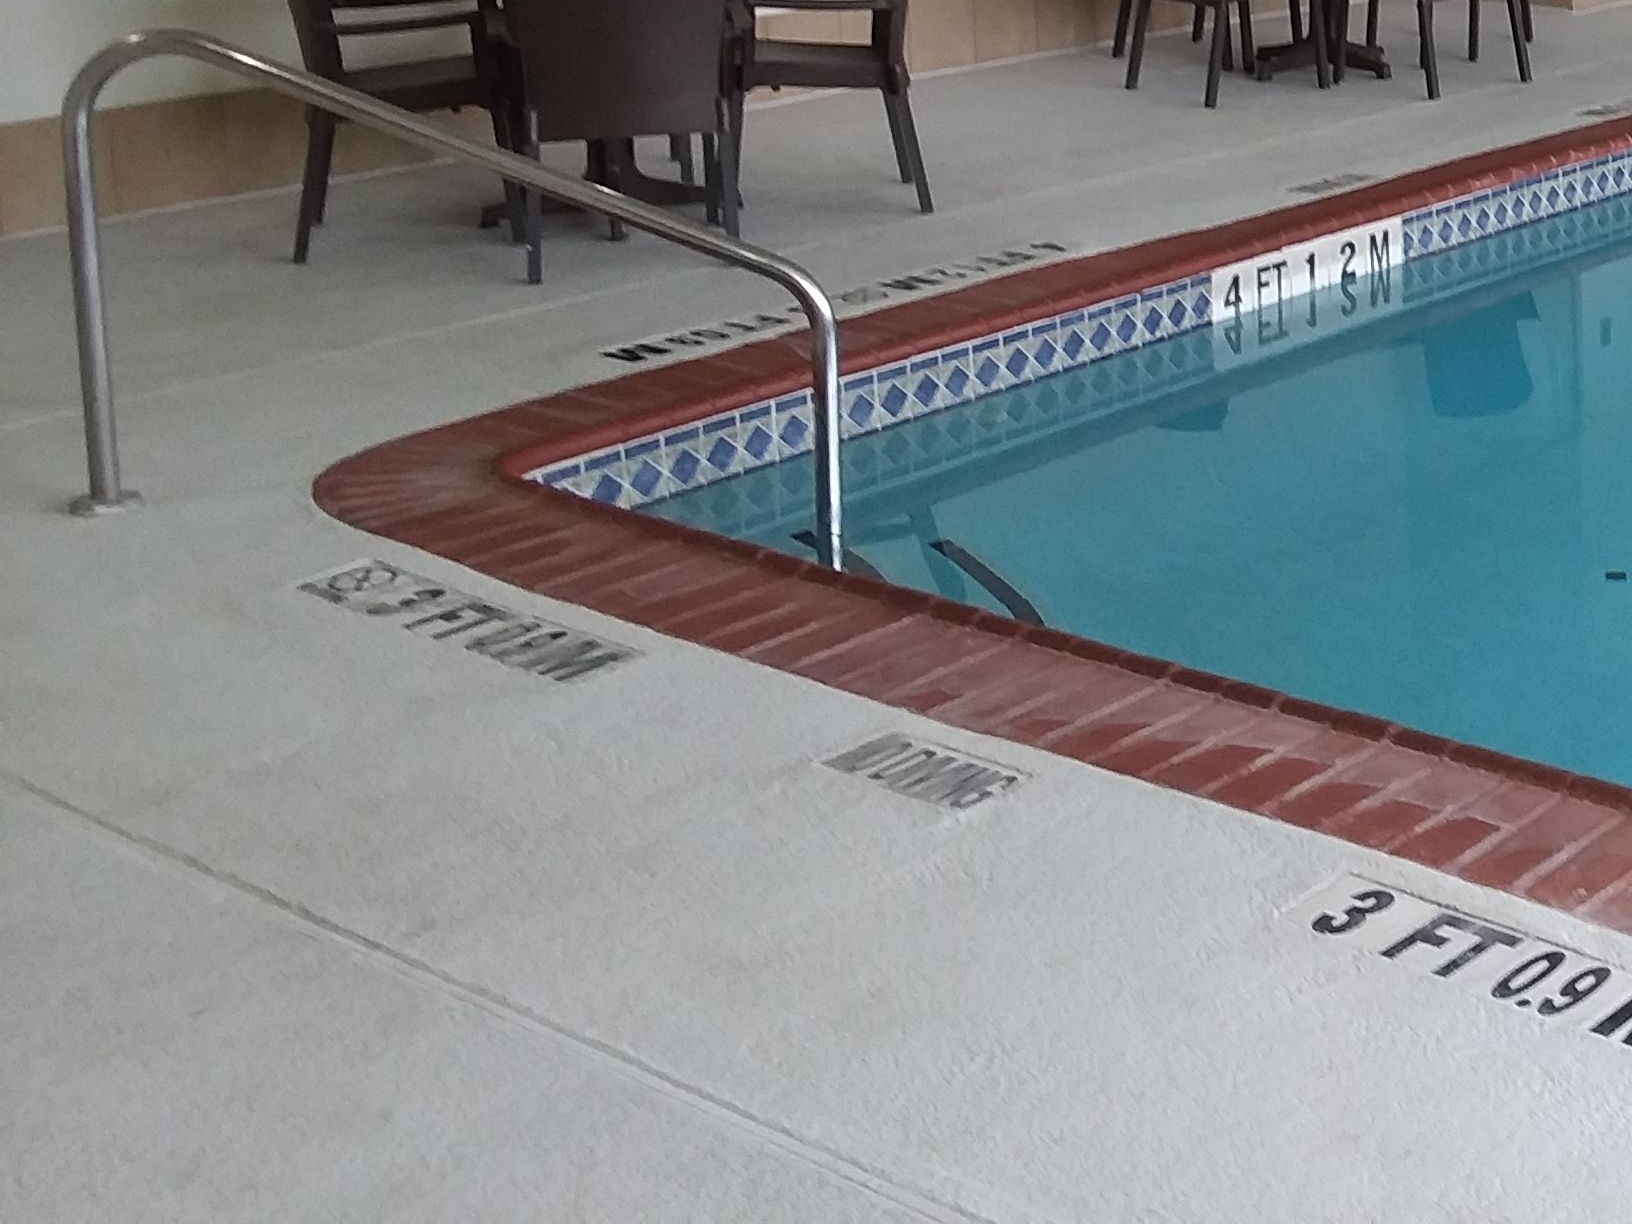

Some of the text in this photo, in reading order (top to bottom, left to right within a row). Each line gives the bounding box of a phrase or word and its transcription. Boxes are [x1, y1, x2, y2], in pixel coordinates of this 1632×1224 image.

[1224, 273, 1244, 314] 4
[1256, 260, 1289, 312] FT
[1311, 890, 1396, 935] 3
[1379, 913, 1524, 978] FT
[1491, 951, 1613, 1016] 0.9
